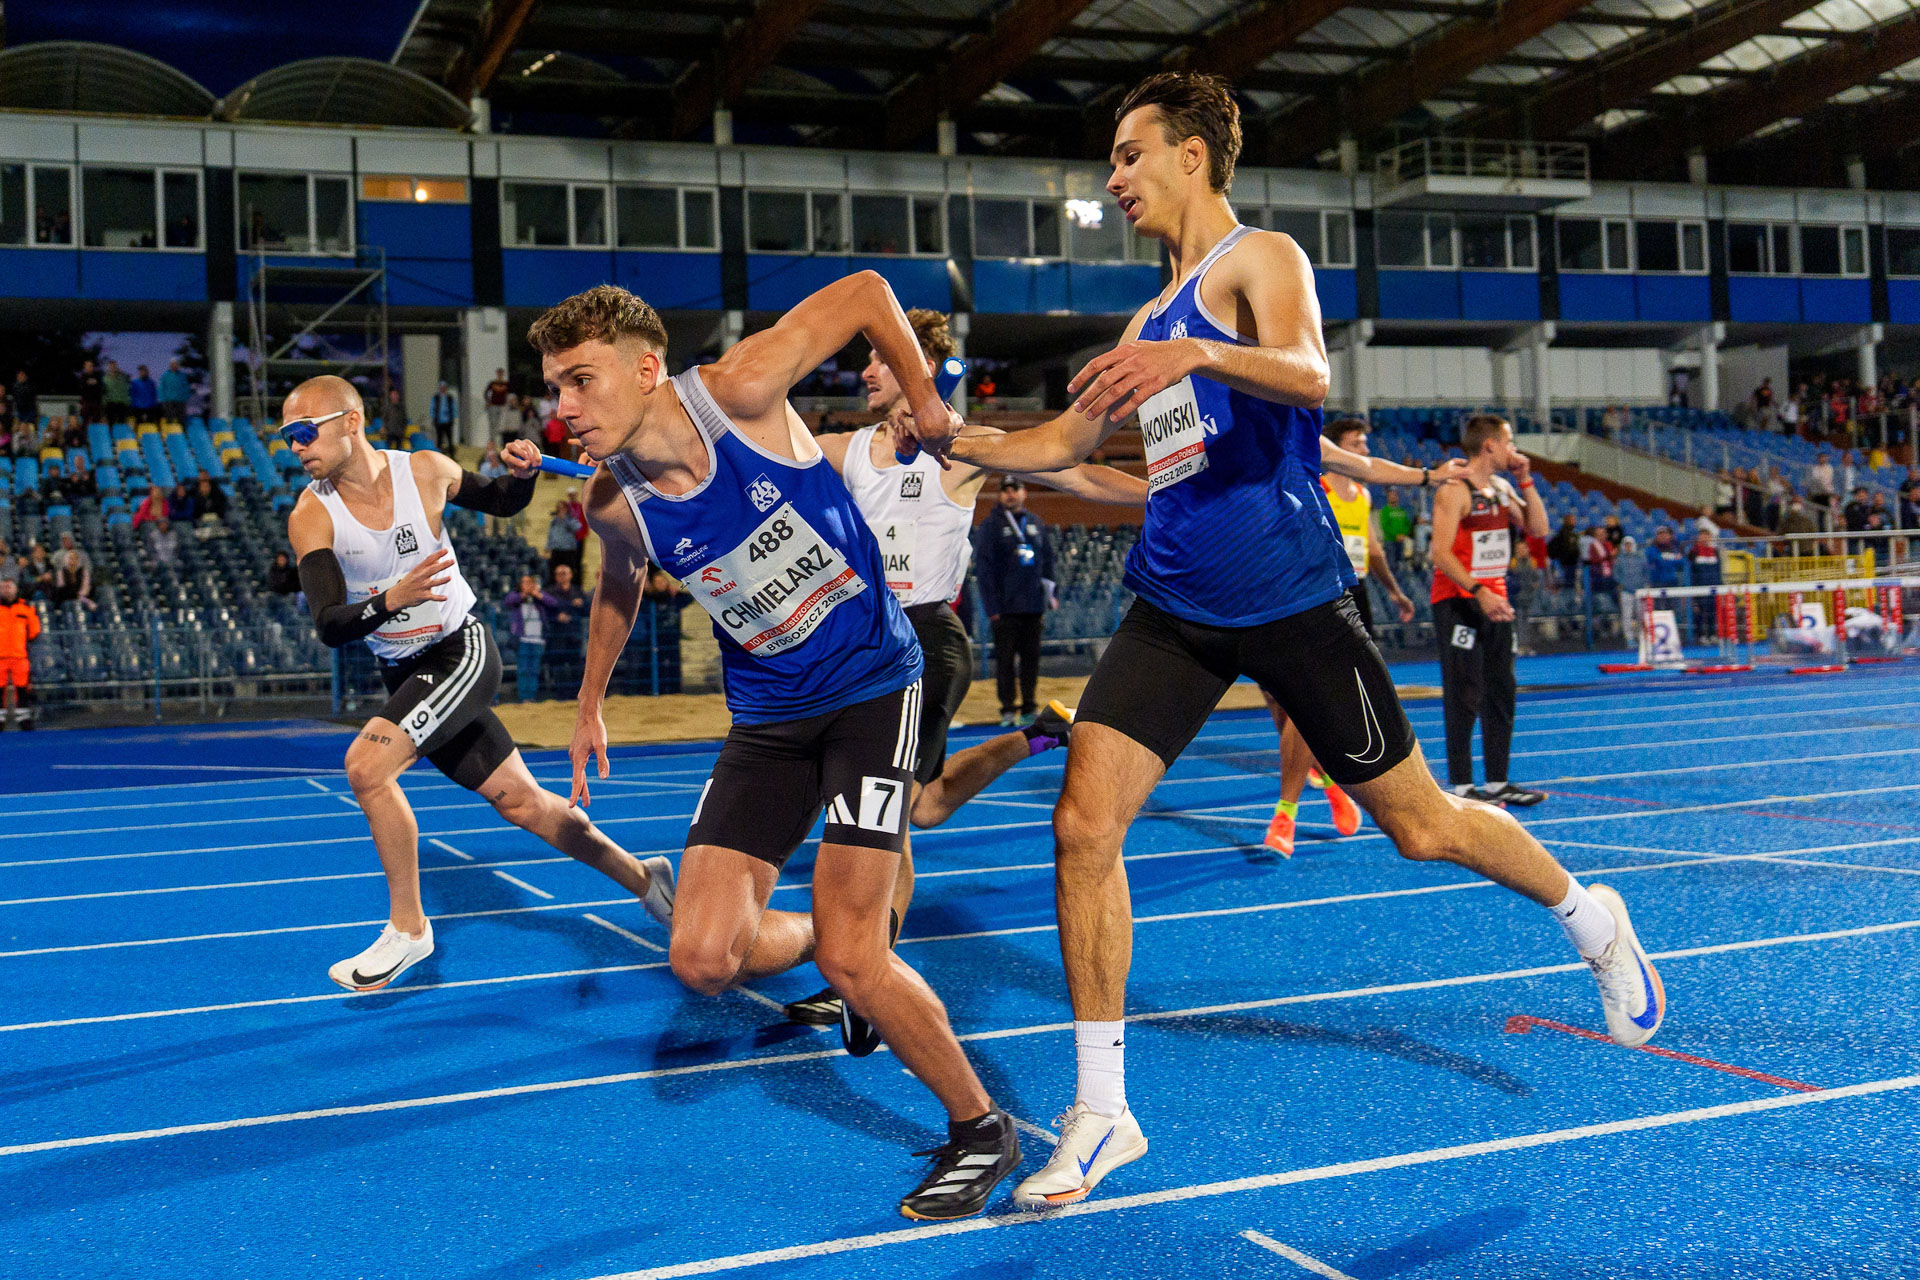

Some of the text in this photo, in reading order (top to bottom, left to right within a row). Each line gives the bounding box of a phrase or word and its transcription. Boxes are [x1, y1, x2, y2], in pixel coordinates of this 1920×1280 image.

[1178, 445, 1199, 460] Polski
[1174, 461, 1193, 478] 2025
[748, 519, 794, 563] 488
[886, 525, 896, 540] 4
[882, 554, 910, 572] IAK
[710, 580, 738, 598] ORLEN
[721, 543, 833, 630] CHMIELARZ
[749, 635, 766, 648] 101.
[779, 590, 825, 633] Mistrzostwa
[824, 573, 849, 592] Polski
[766, 588, 849, 652] BYDGOSZCZ 2025
[1457, 628, 1470, 645] 8
[874, 782, 896, 826] 7
